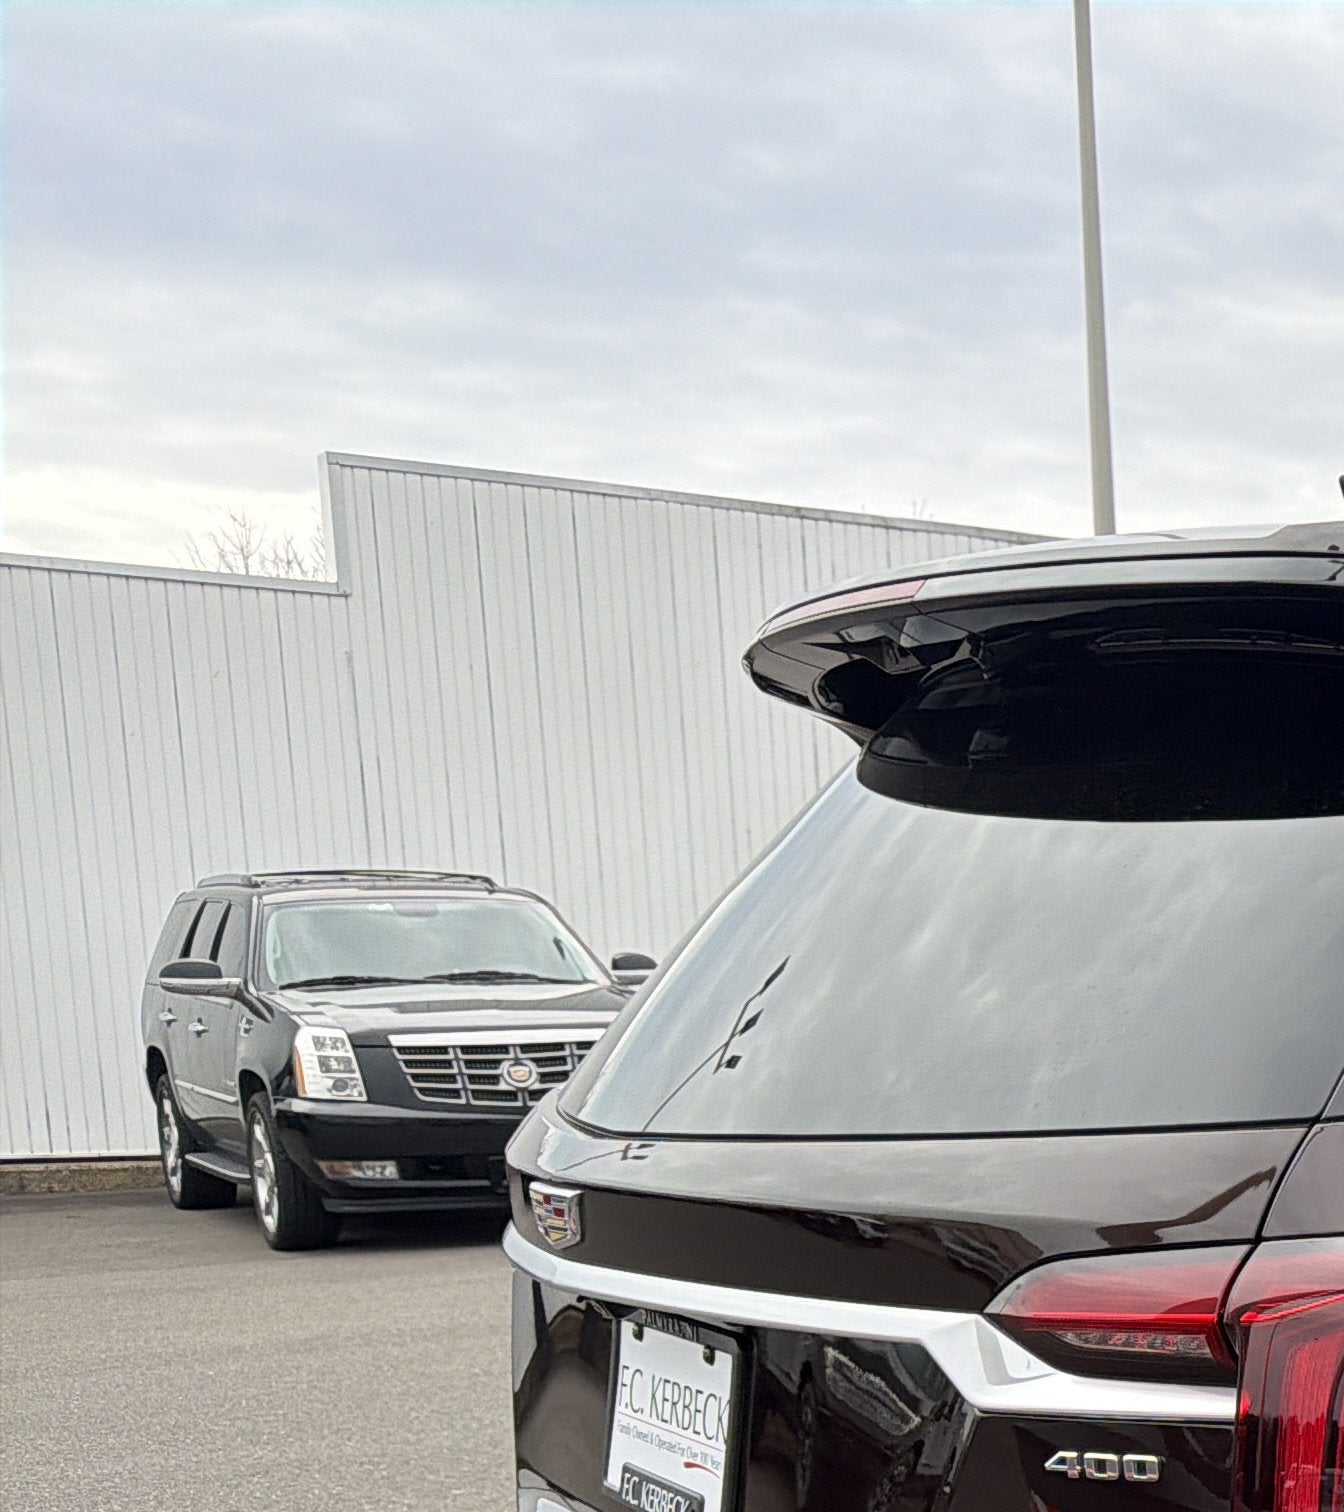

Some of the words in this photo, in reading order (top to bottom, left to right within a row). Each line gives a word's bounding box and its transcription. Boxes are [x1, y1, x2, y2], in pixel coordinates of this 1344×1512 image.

[619, 1365, 644, 1415] F.C.
[649, 1374, 730, 1443] KERBECK
[1044, 1450, 1160, 1482] 400
